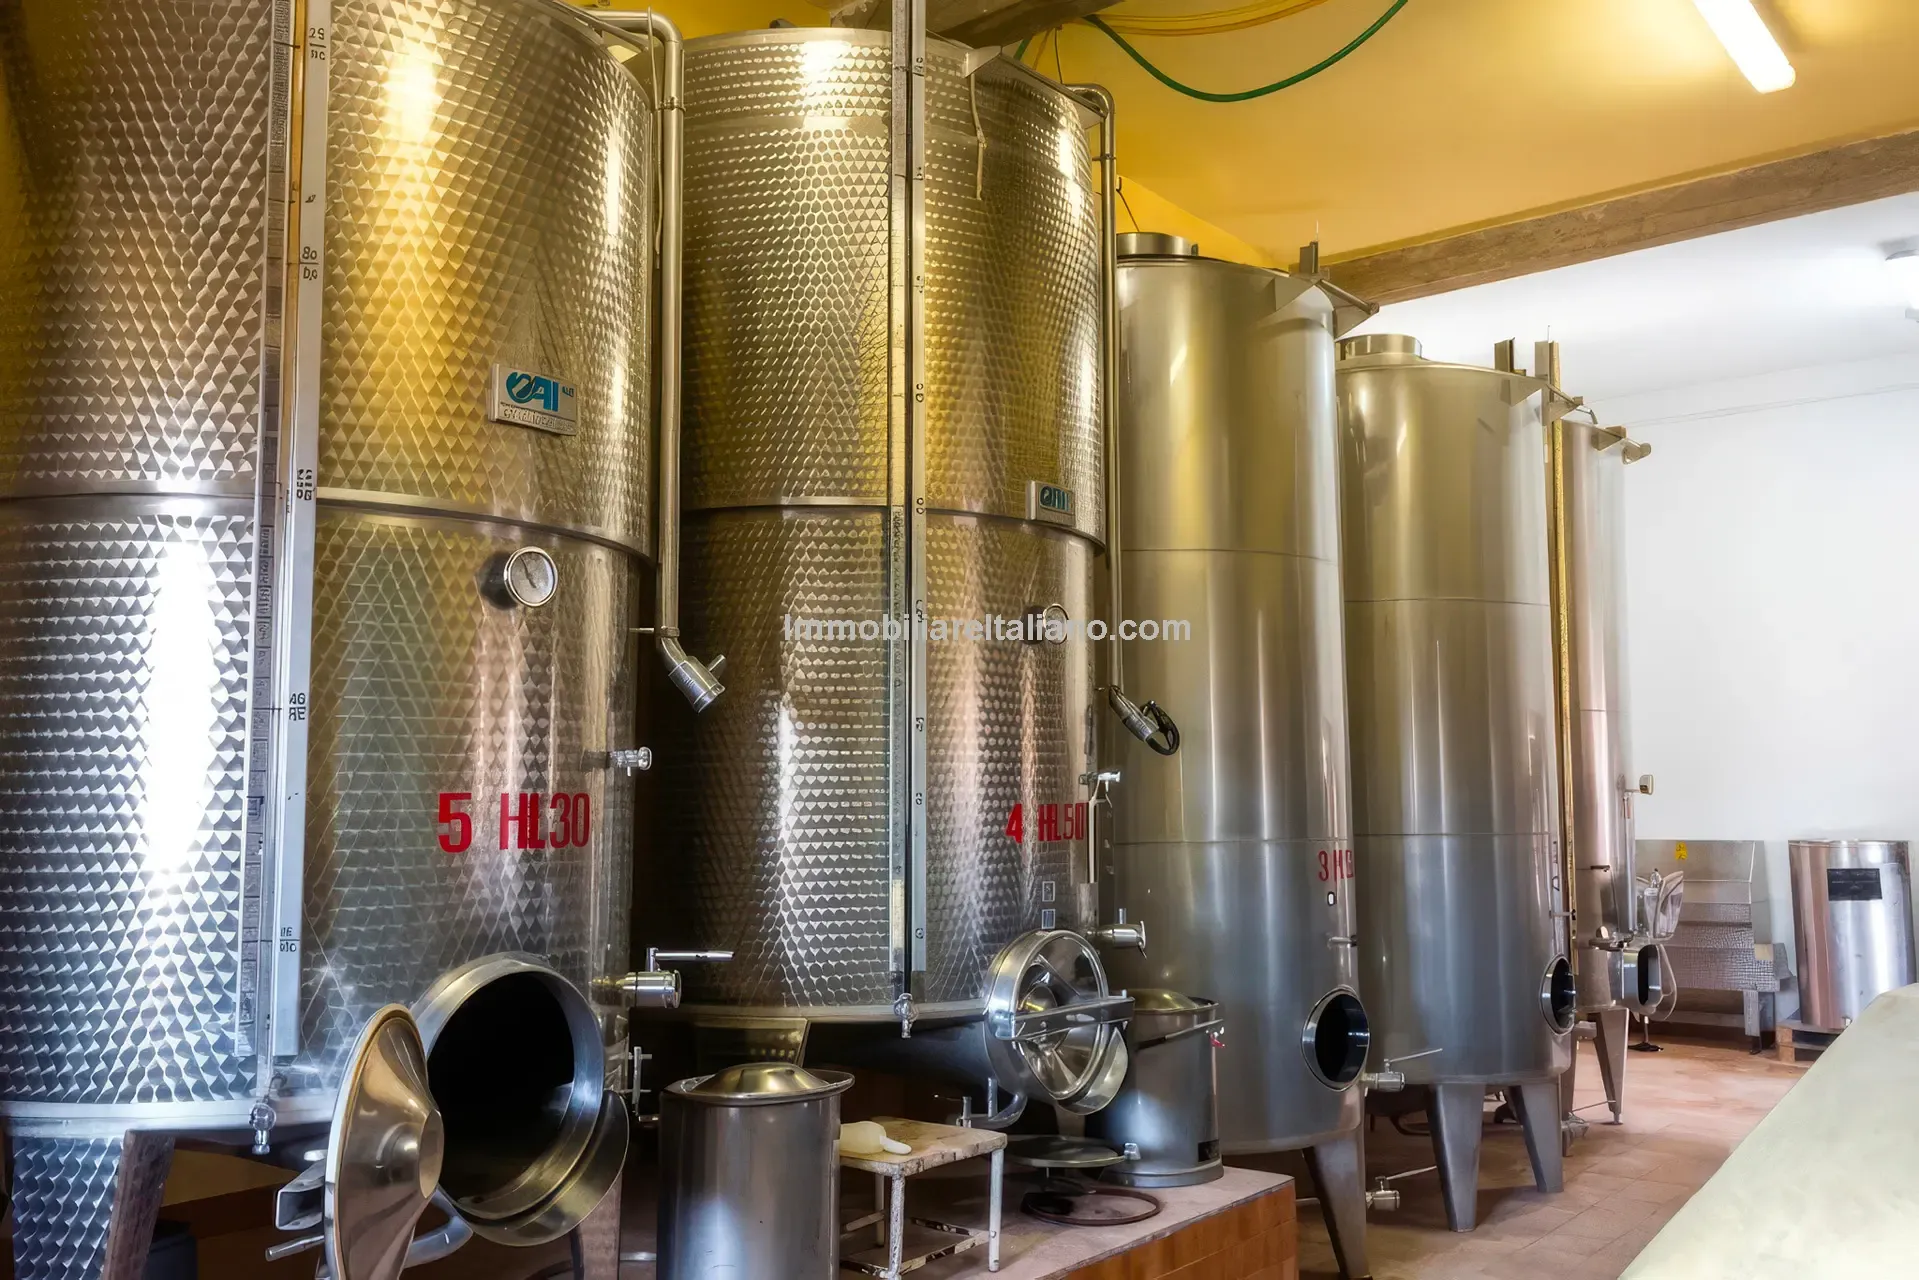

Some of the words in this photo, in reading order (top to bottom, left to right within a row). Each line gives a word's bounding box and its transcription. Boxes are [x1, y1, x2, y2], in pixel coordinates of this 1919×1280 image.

[438, 792, 472, 853] 5
[500, 792, 590, 850] HL30
[1005, 803, 1023, 843] 4
